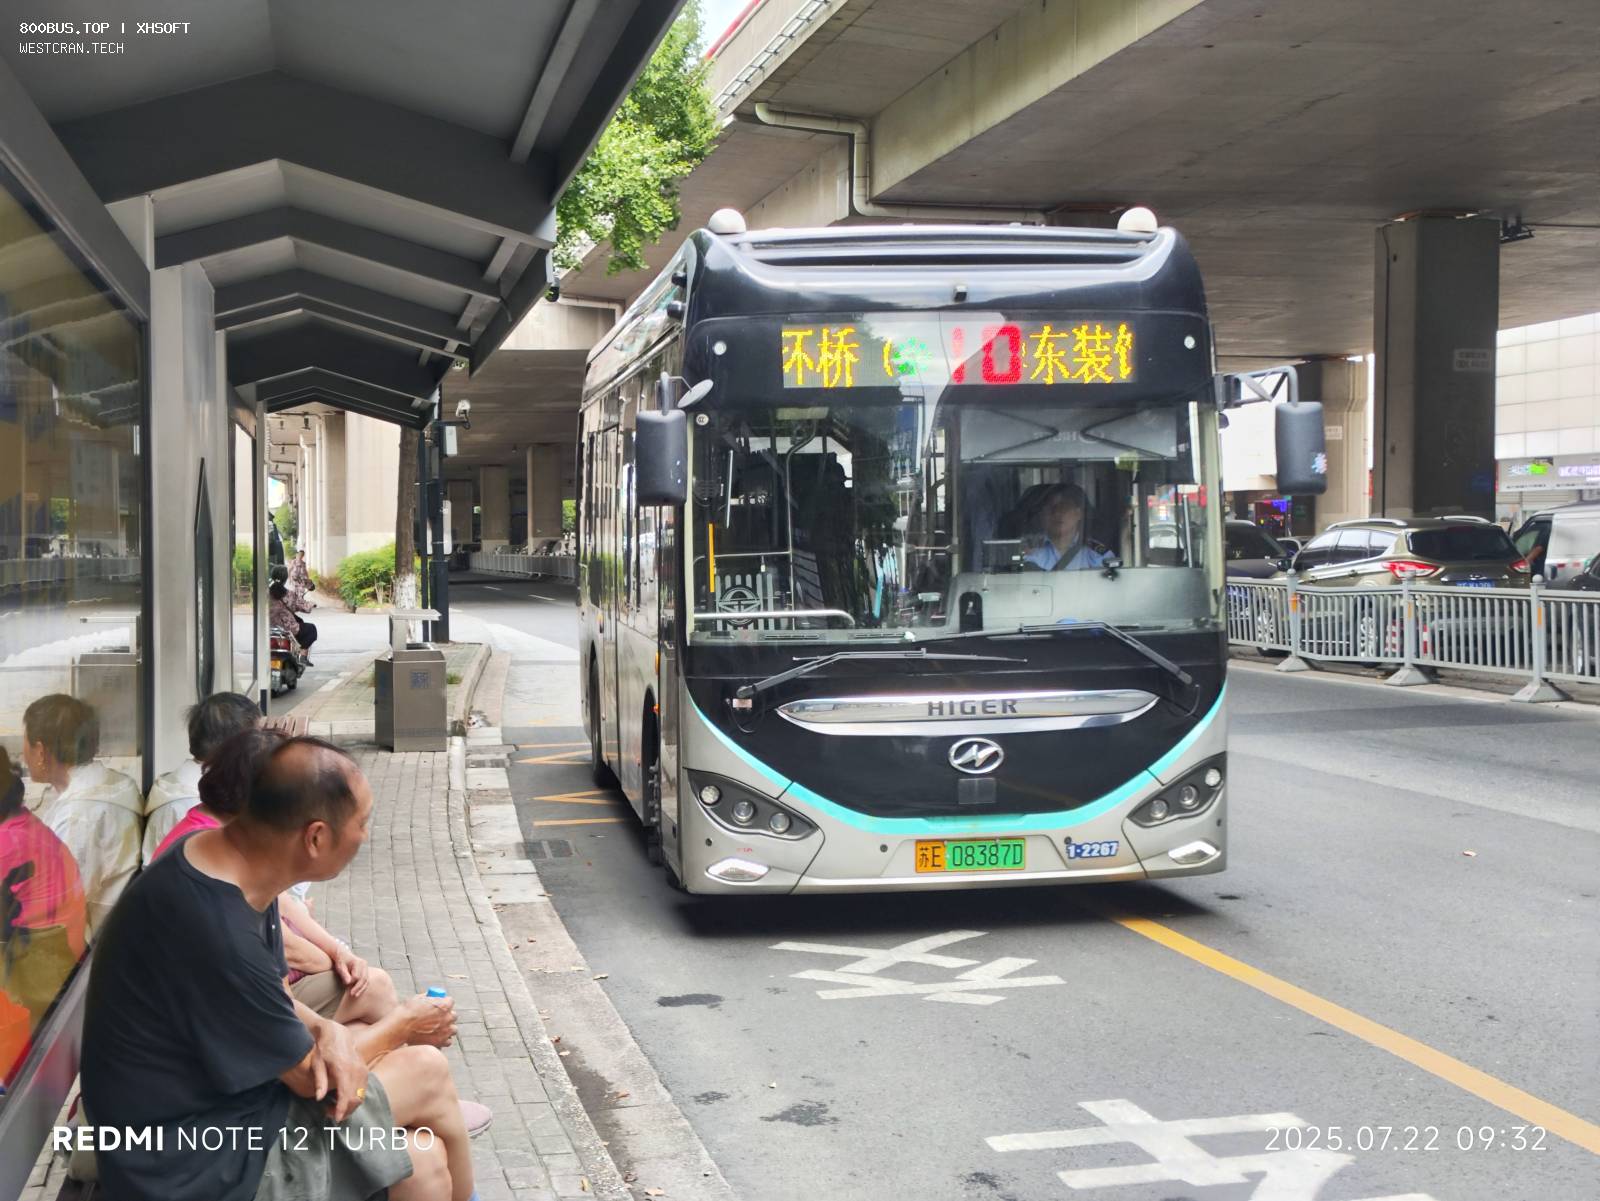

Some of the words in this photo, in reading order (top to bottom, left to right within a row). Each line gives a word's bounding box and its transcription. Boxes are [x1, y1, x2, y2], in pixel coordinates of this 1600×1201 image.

[951, 322, 1024, 385] 10
[927, 698, 1019, 717] HIGER
[952, 844, 1023, 867] 08387D
